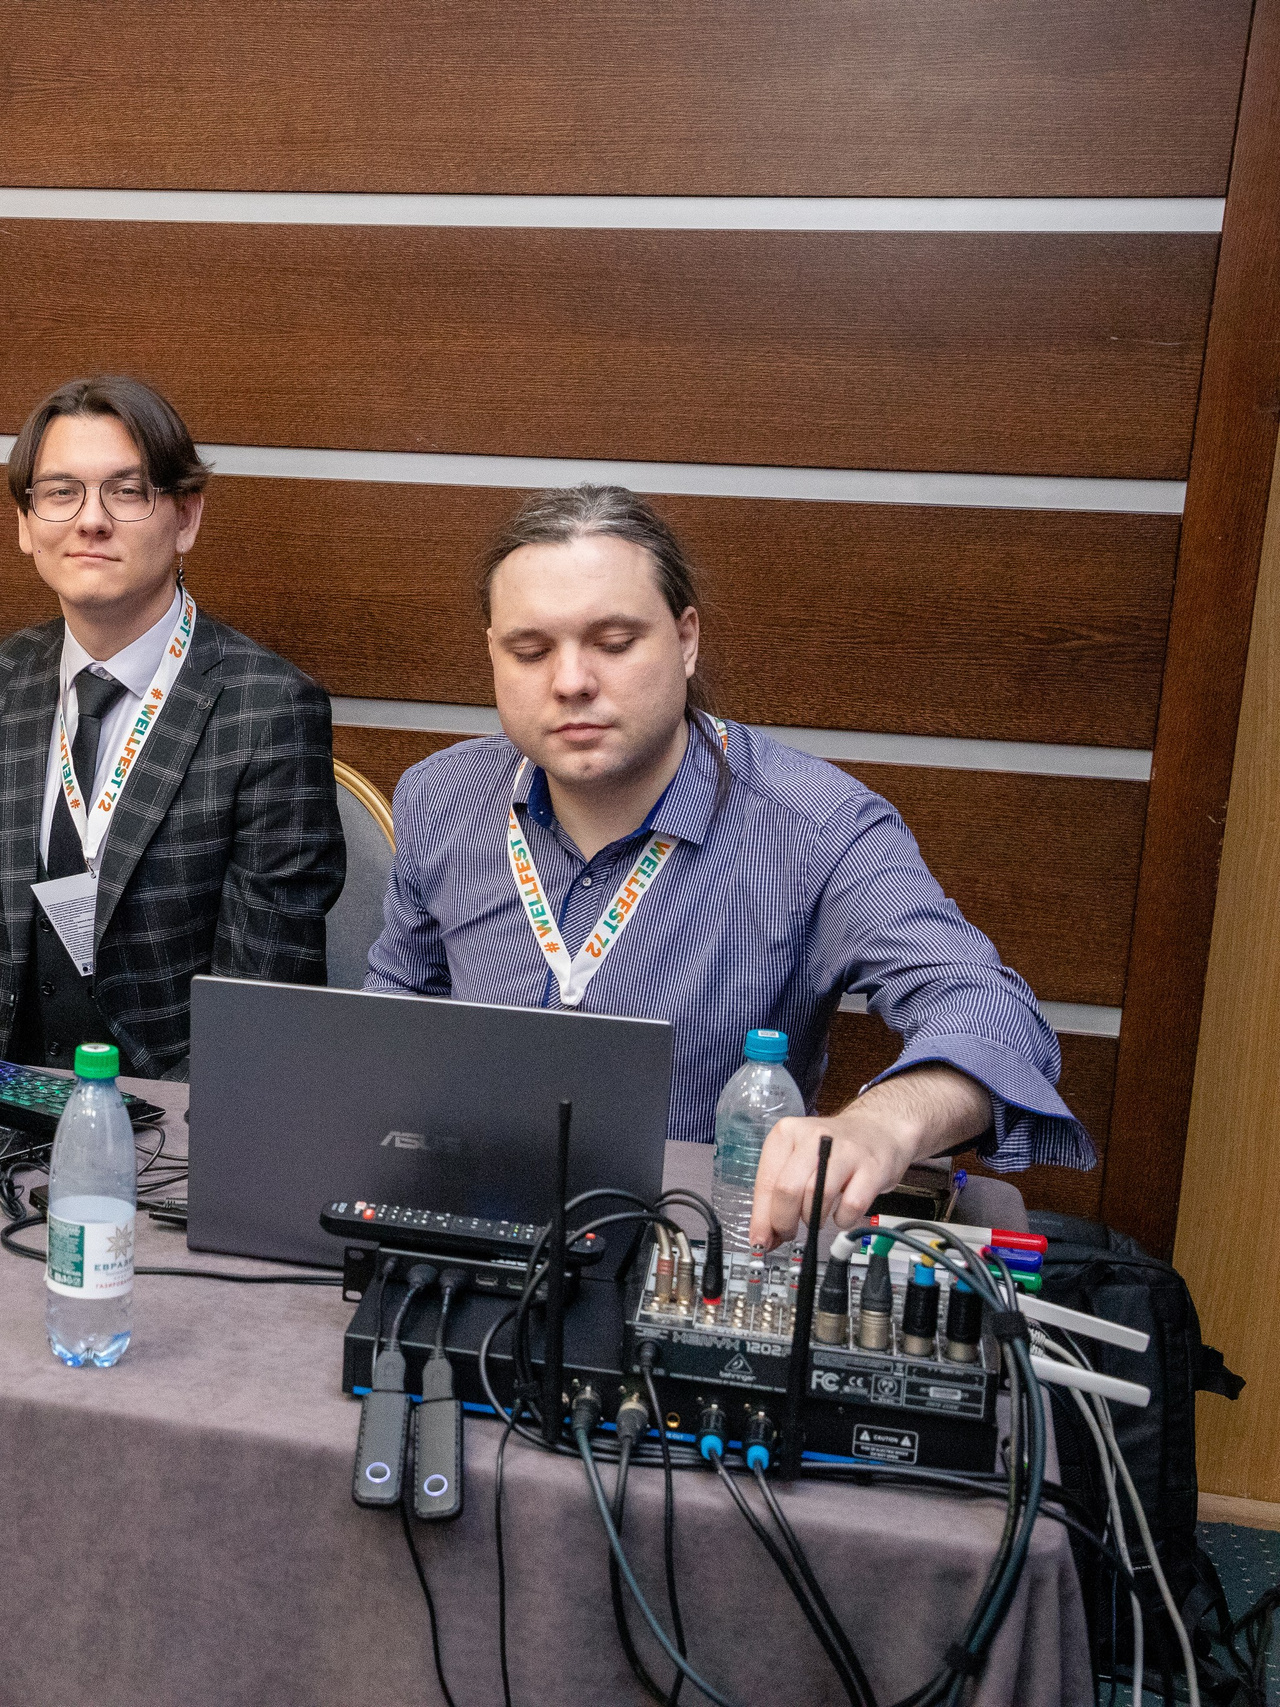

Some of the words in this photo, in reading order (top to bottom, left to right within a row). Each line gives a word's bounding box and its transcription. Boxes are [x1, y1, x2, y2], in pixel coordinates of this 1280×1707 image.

[169, 636, 187, 659] 72
[111, 703, 158, 789] WELLFEST
[97, 791, 118, 812] 72
[509, 839, 553, 939] WELLFEST
[602, 840, 671, 935] WELLFEST
[584, 933, 610, 958] 72
[719, 1370, 756, 1382] behringer
[872, 1434, 899, 1444] CAUTION
